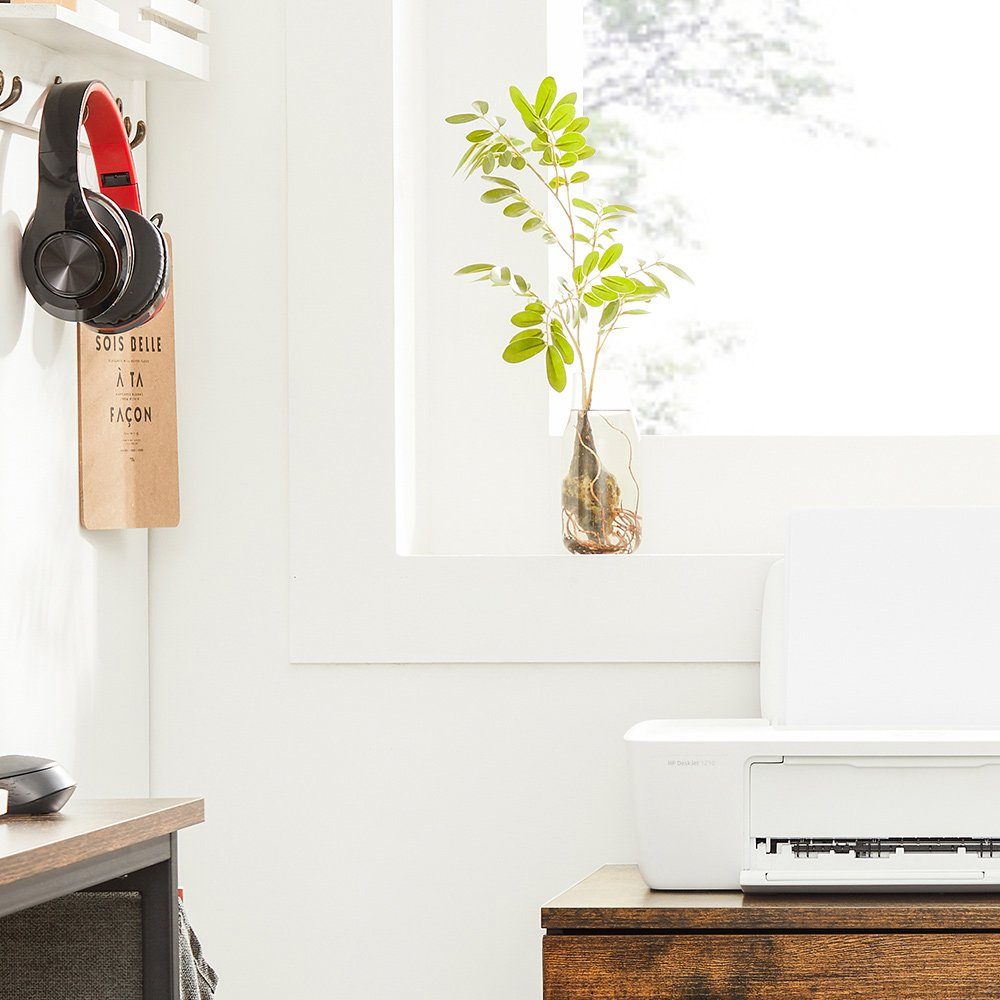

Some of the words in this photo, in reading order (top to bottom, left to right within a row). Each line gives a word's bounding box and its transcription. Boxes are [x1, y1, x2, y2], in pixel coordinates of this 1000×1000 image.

[96, 335, 124, 351] SOIS
[131, 336, 162, 352] BELLE
[116, 367, 124, 387] À
[130, 372, 144, 387] TA
[110, 407, 152, 427] FAÇON
